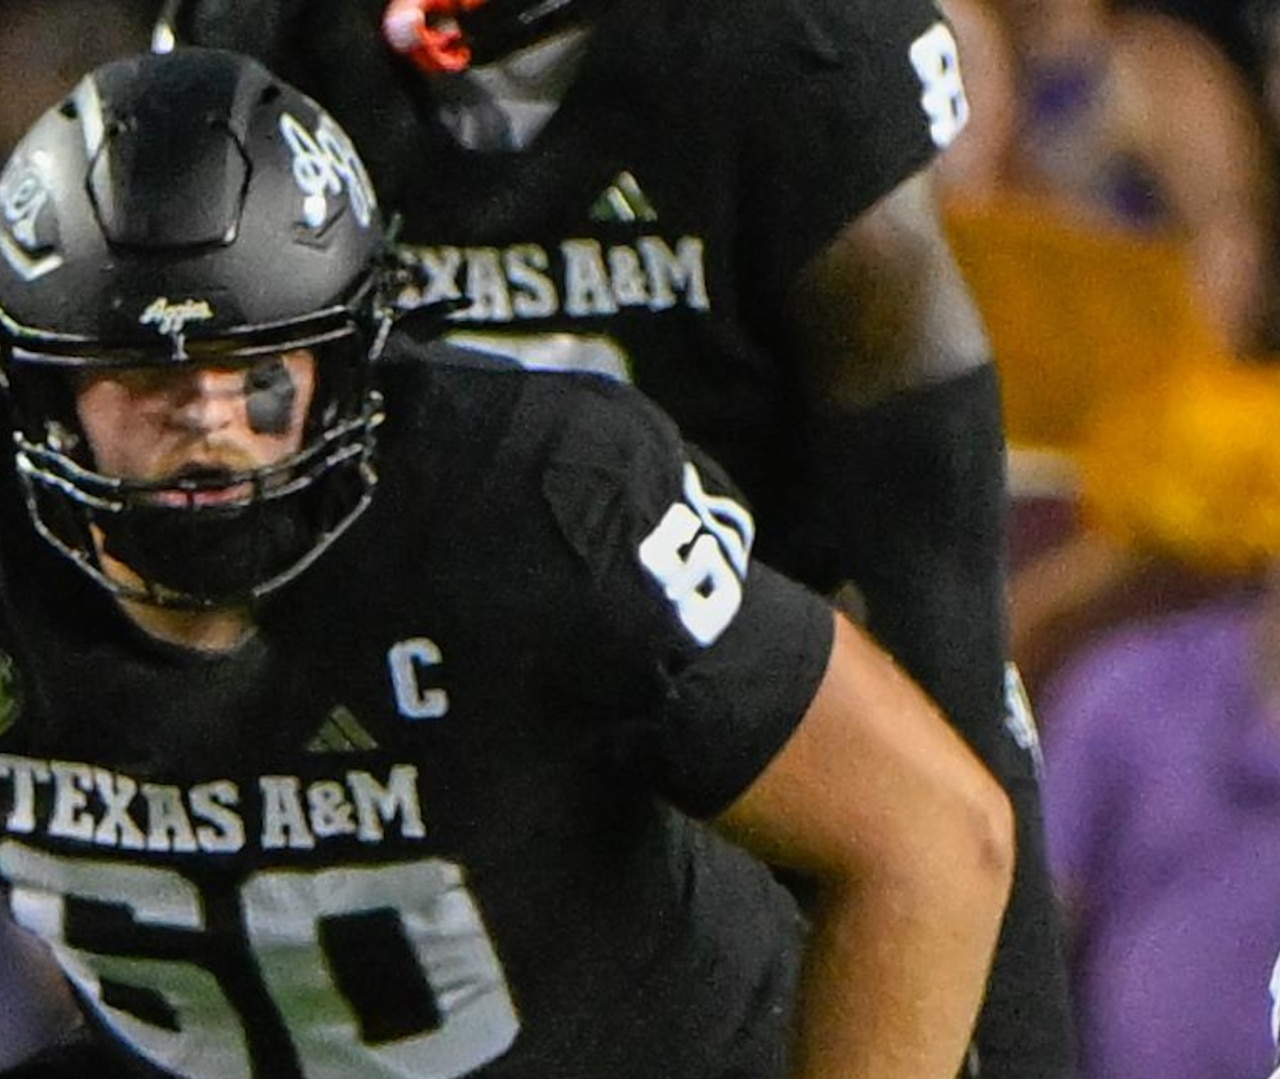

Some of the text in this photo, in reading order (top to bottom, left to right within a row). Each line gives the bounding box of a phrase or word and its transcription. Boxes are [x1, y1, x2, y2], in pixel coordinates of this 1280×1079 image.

[561, 237, 710, 313] A&M
[388, 638, 450, 720] C
[259, 763, 427, 850] A&M
